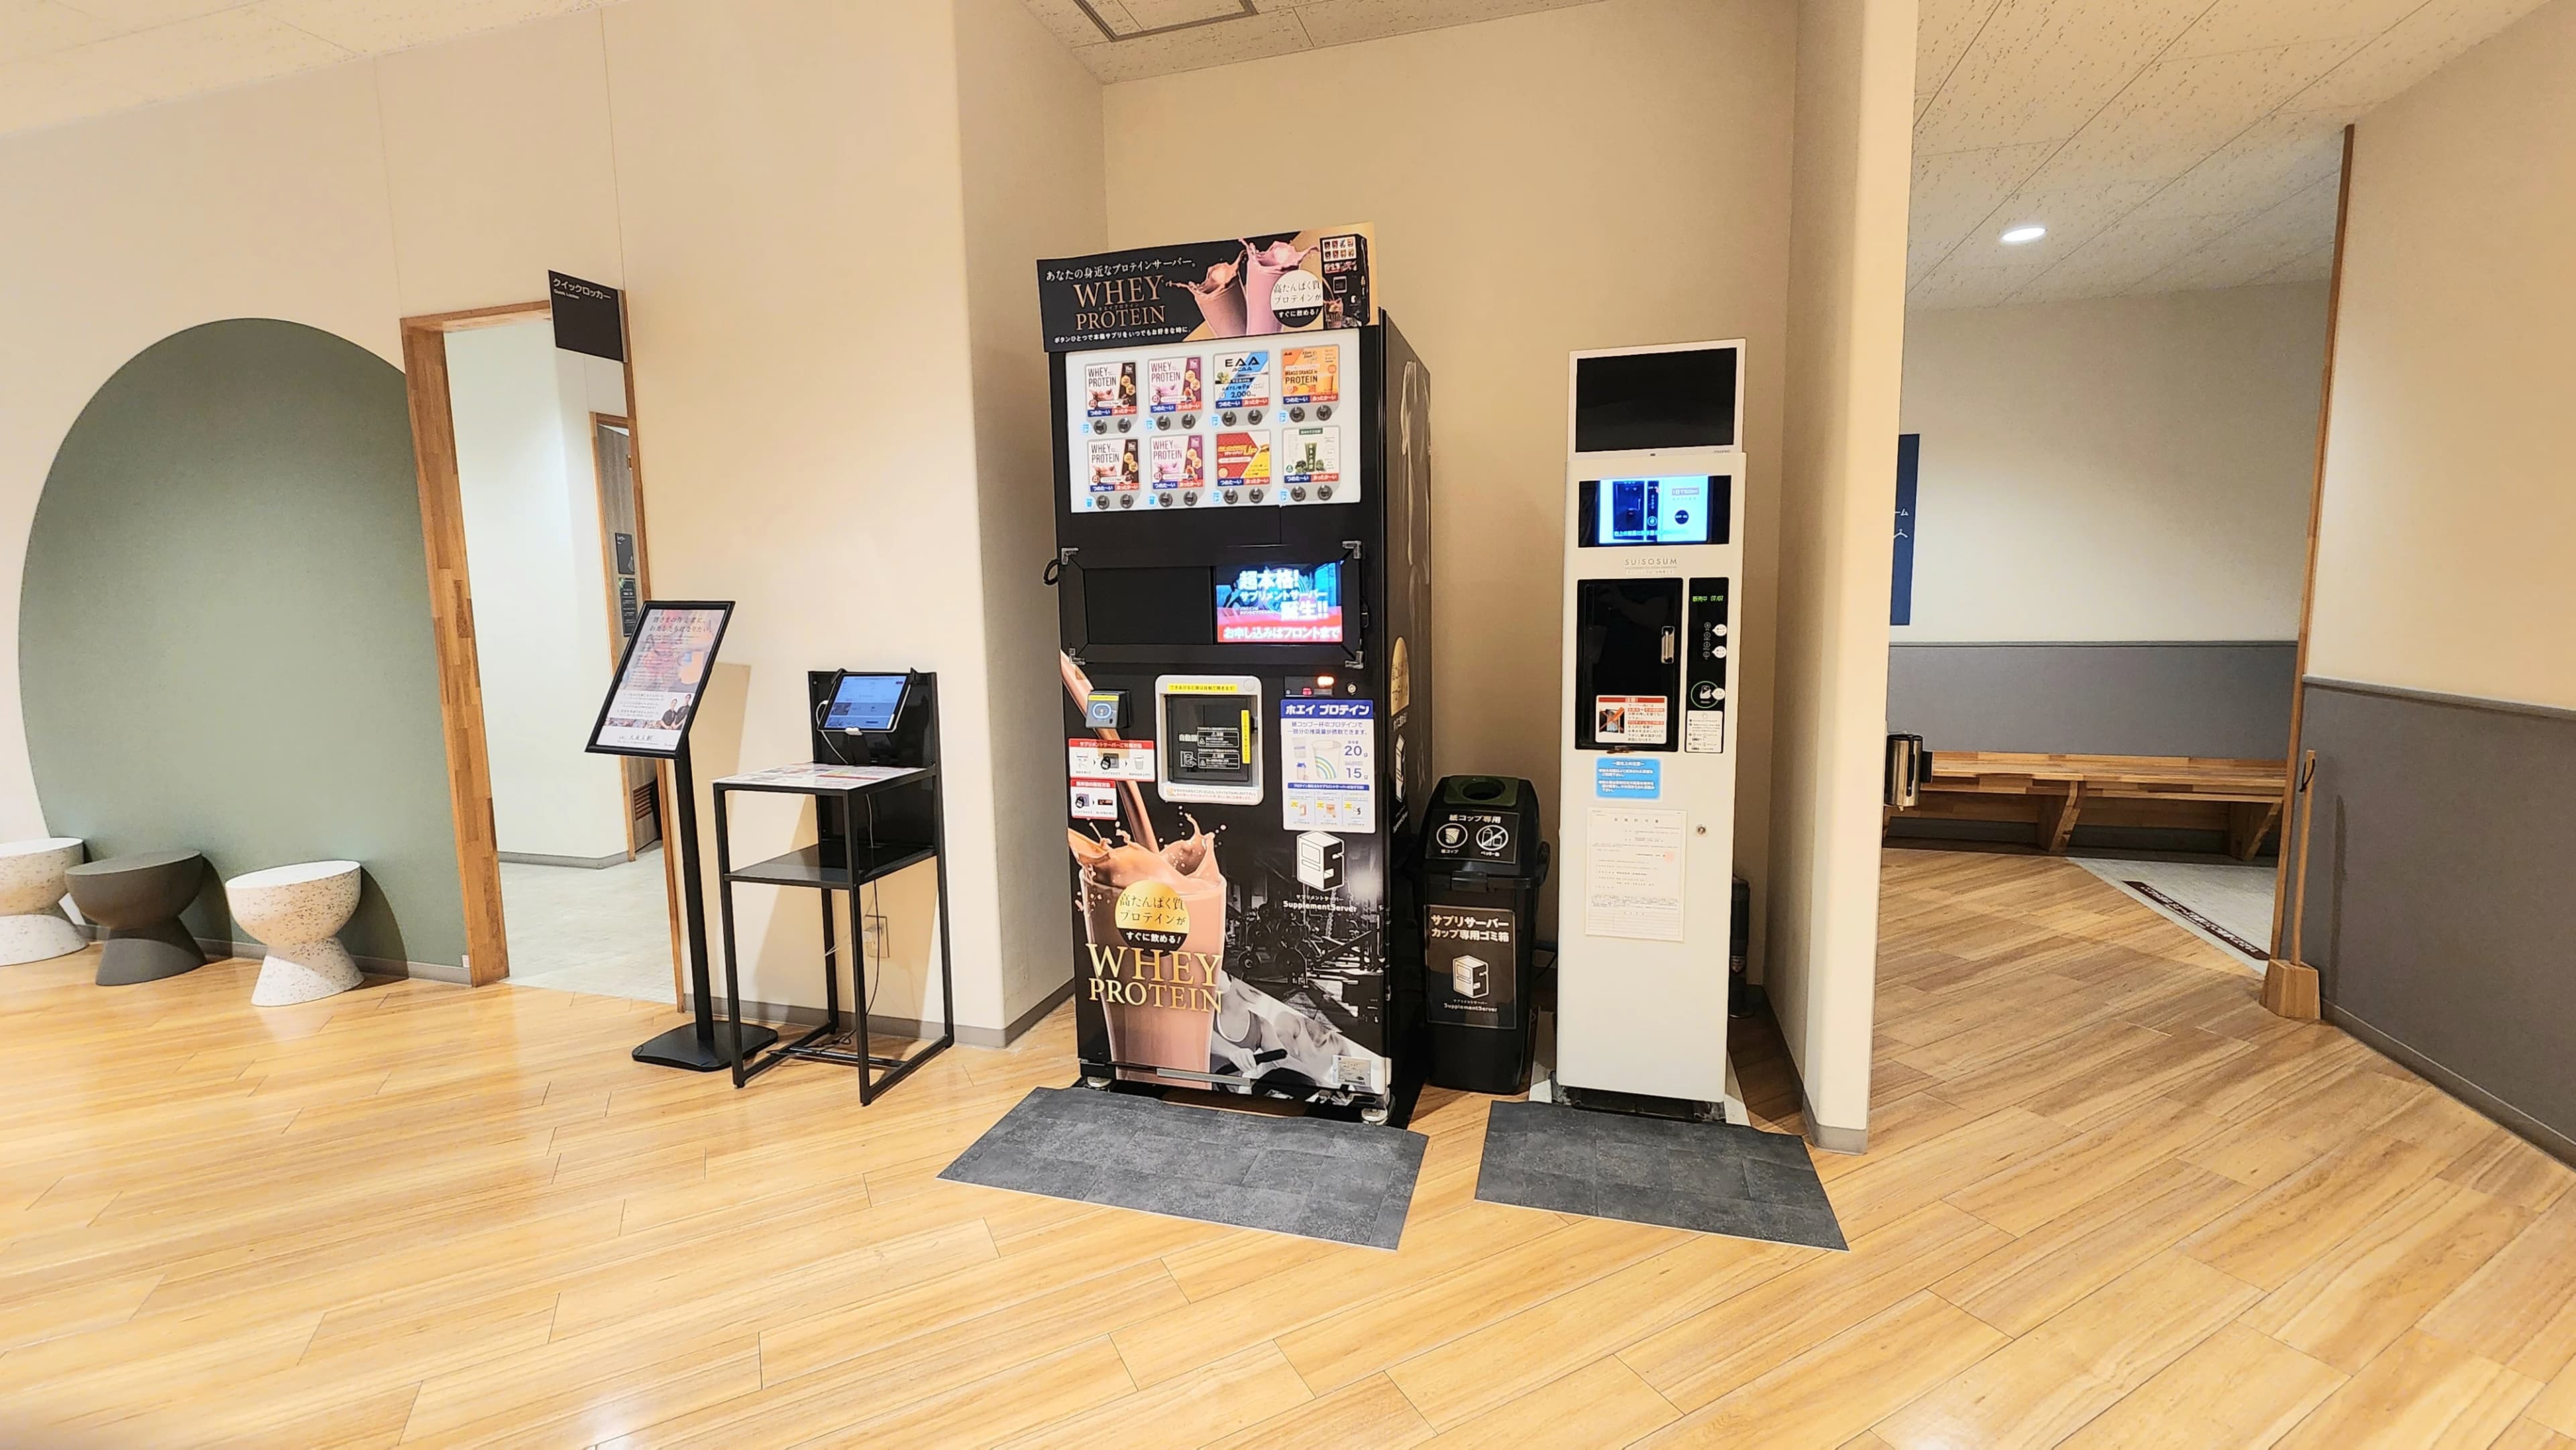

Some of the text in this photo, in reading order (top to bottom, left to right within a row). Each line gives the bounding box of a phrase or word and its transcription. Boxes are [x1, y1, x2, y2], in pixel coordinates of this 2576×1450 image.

[1046, 257, 1195, 281] あなたの身近なプロテインサーバー。
[553, 278, 611, 299] クイックロッカー
[1073, 274, 1163, 308] WHEY
[1075, 306, 1165, 331] PROTEIN
[1151, 361, 1172, 372] WHEY
[1225, 356, 1260, 367] EAA
[1088, 367, 1108, 378] WHEY
[1151, 372, 1181, 383] PROTEIN
[1088, 376, 1117, 388] PROTEIN
[1285, 376, 1318, 384] PROTEIN
[1091, 444, 1111, 453] WHEY
[1152, 440, 1173, 450] WHEY
[1091, 453, 1120, 463] PROTEIN
[1153, 449, 1182, 460] PROTEIN
[1239, 569, 1299, 590] 超本格!
[1240, 589, 1328, 602] サプリメントサーバー
[1224, 626, 1340, 639] お申し込みはフロントまで
[1285, 704, 1370, 716] ホエイ プロテイン
[1449, 814, 1501, 824] 紙コップ専用
[1120, 893, 1185, 911] 高たんぱく質
[1283, 901, 1357, 913] SupplementServer
[1120, 911, 1186, 926] プロテインが
[1431, 915, 1509, 928] サプリサーバー
[1126, 931, 1181, 944] すぐに飲める!
[1432, 928, 1509, 942] カップ専用ゴミ箱
[1085, 943, 1222, 987] WHEY
[1089, 978, 1224, 1013] PROTEIN
[1444, 1003, 1498, 1012] SupplementServer
